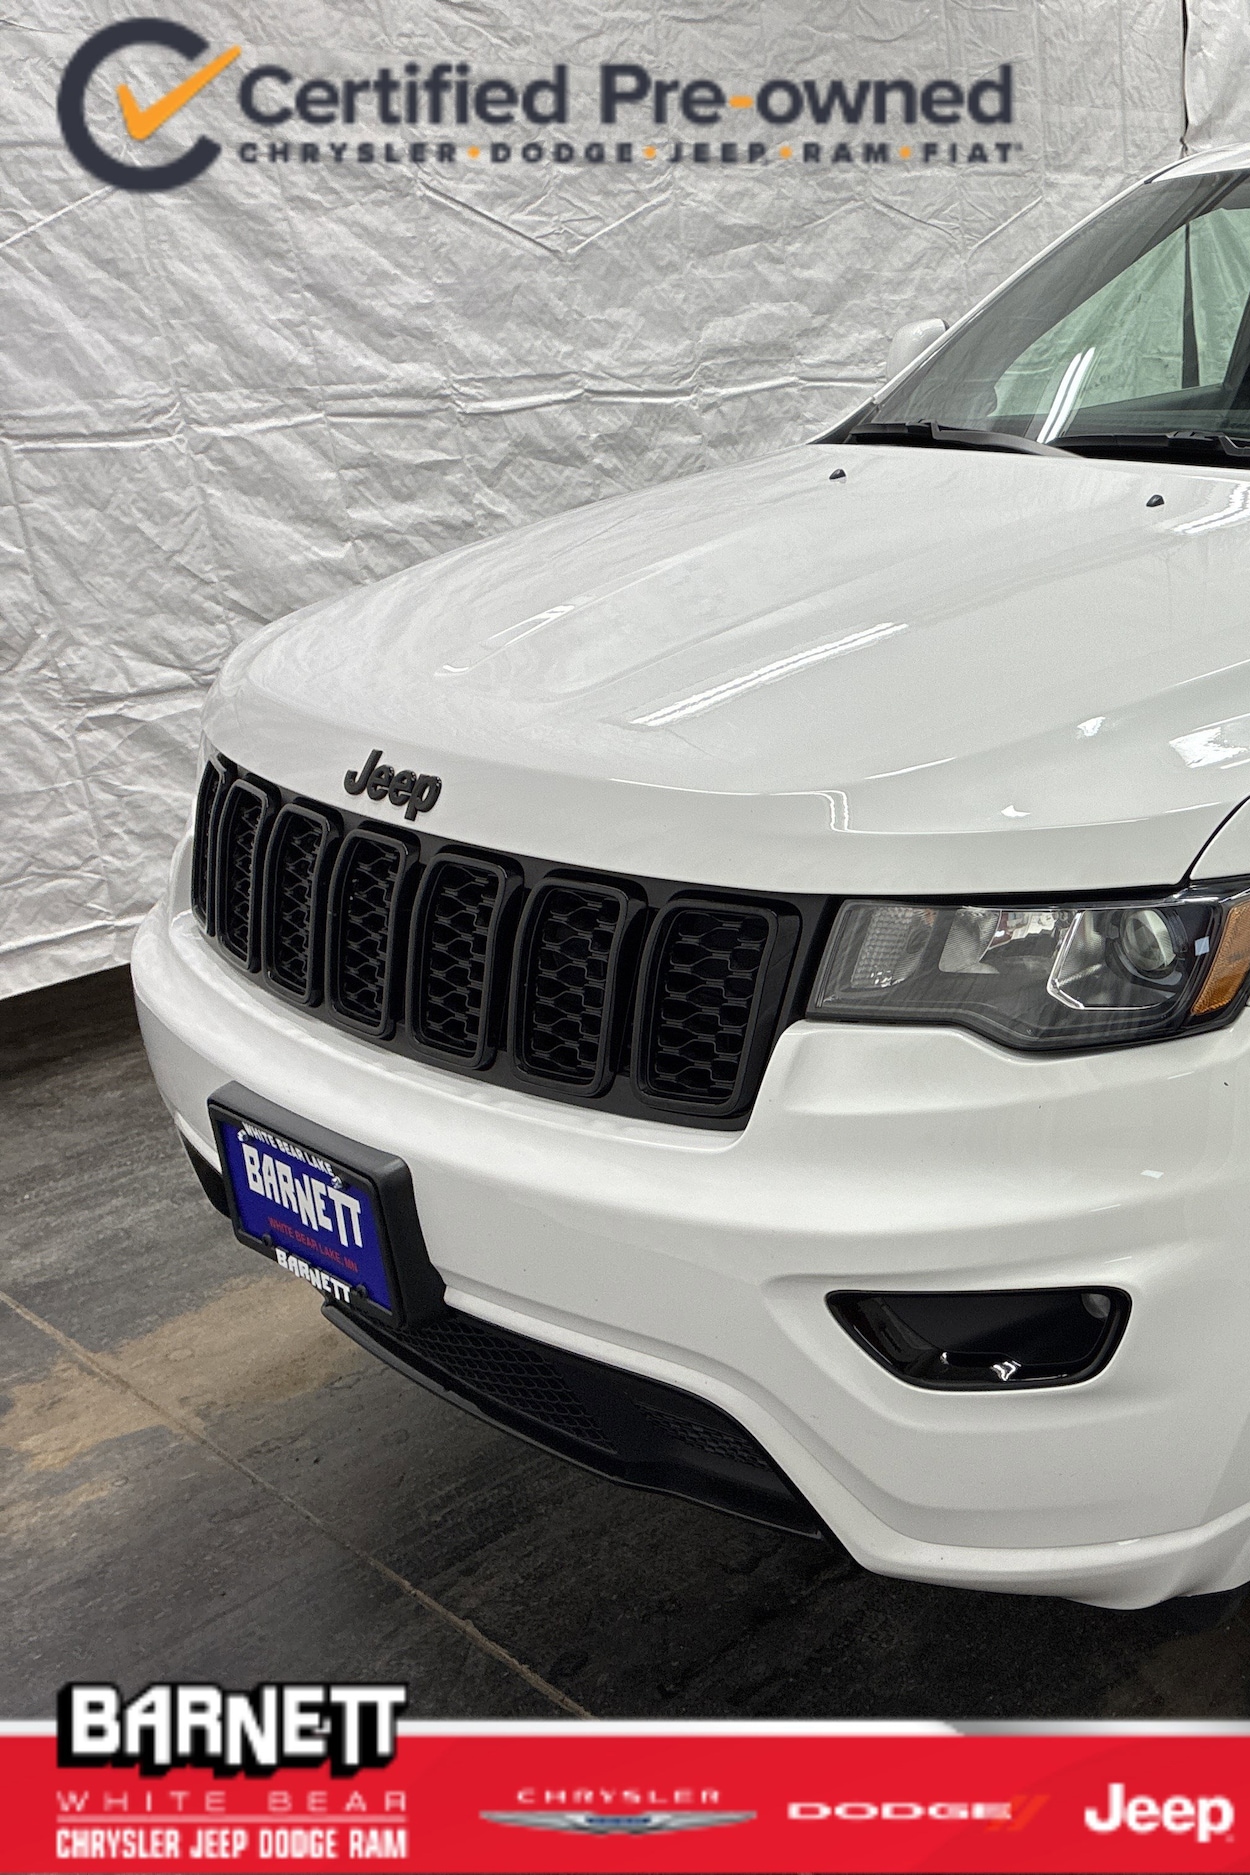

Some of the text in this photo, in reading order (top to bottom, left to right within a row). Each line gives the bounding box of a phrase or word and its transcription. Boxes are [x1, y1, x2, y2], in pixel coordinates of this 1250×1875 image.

[344, 749, 442, 821] Jeep
[242, 1121, 335, 1177] WHITE BEAR LAKE
[242, 1143, 363, 1249] BARNETT
[268, 1216, 295, 1239] WHITE
[294, 1230, 319, 1251] BEAR
[275, 1247, 350, 1304] BARNETT
